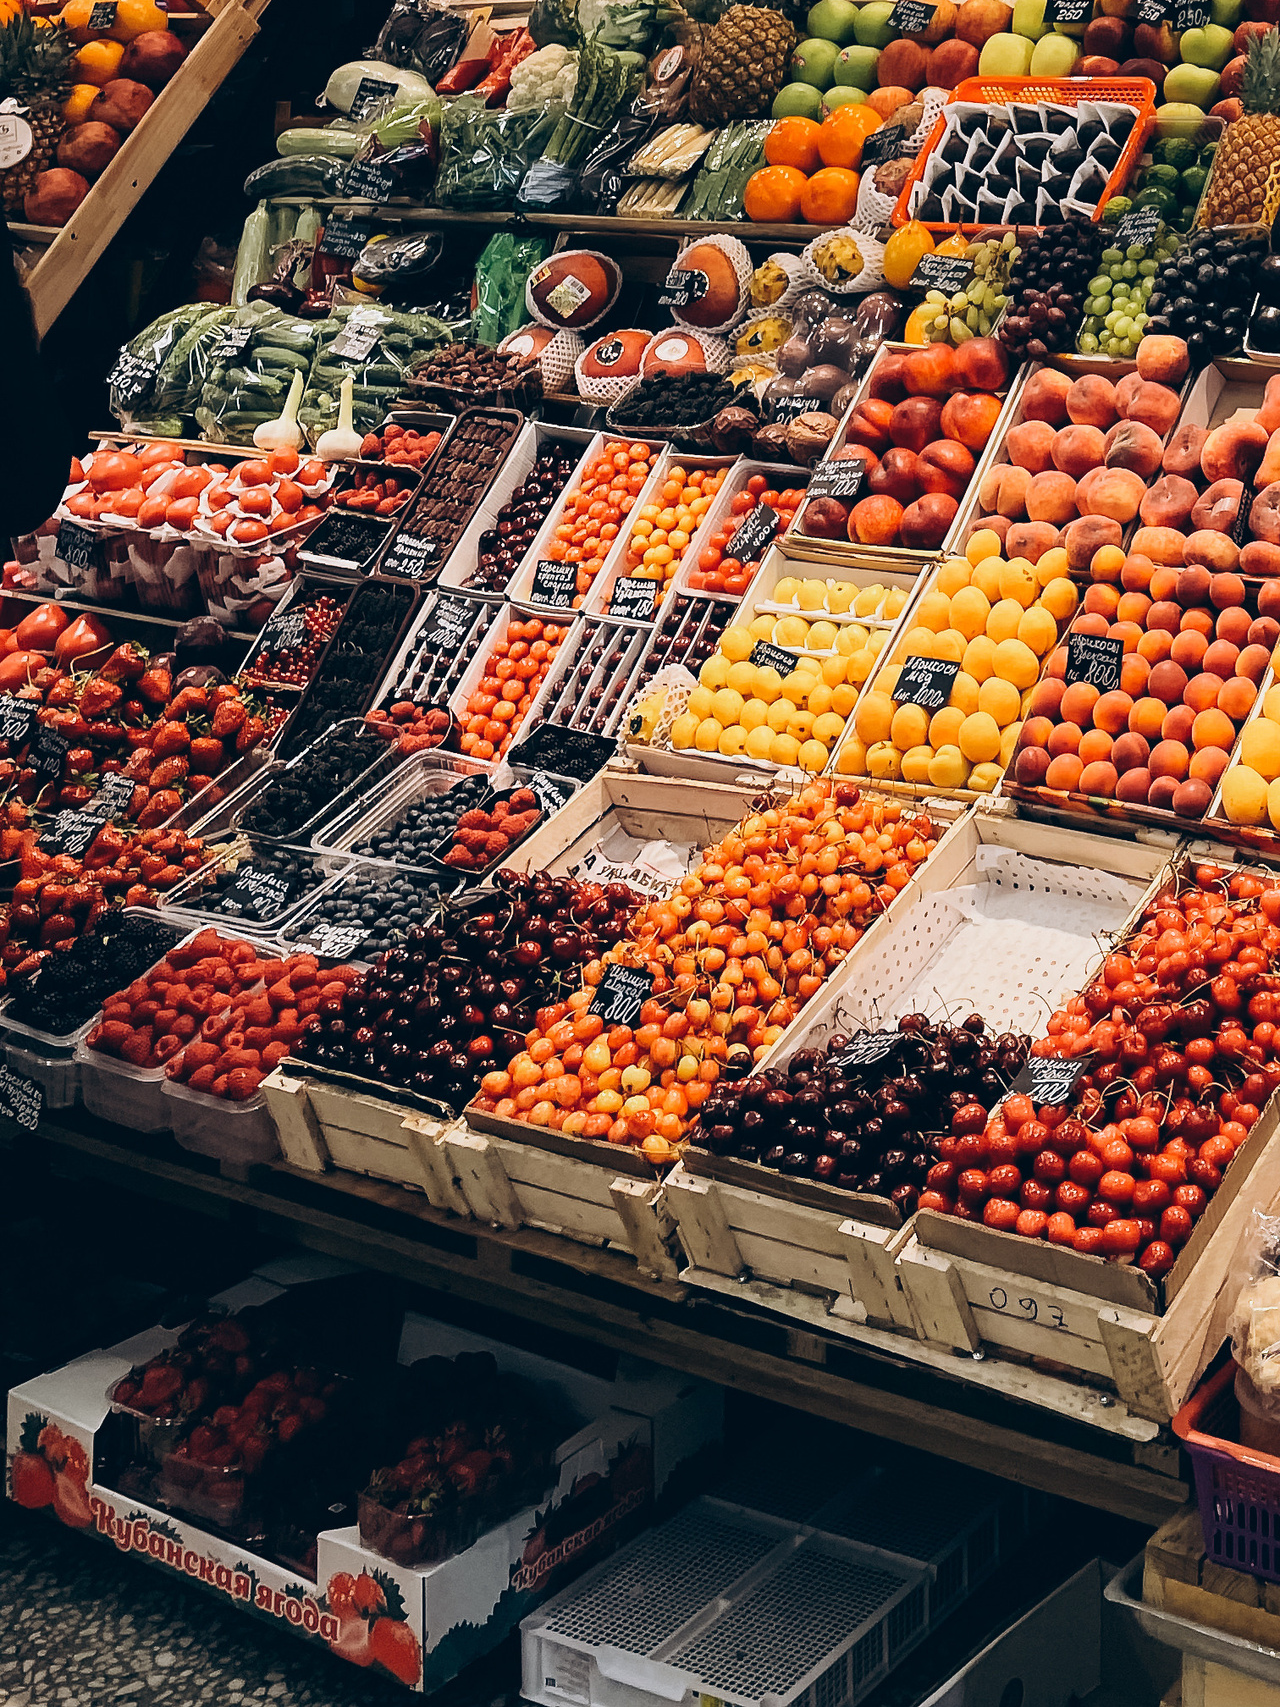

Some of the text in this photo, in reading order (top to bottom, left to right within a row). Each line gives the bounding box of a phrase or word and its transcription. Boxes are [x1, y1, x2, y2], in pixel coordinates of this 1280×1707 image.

[1056, 9, 1084, 21] 250
[90, 1497, 341, 1645] Кубанская ягода
[512, 1517, 603, 1593] Кубанская
